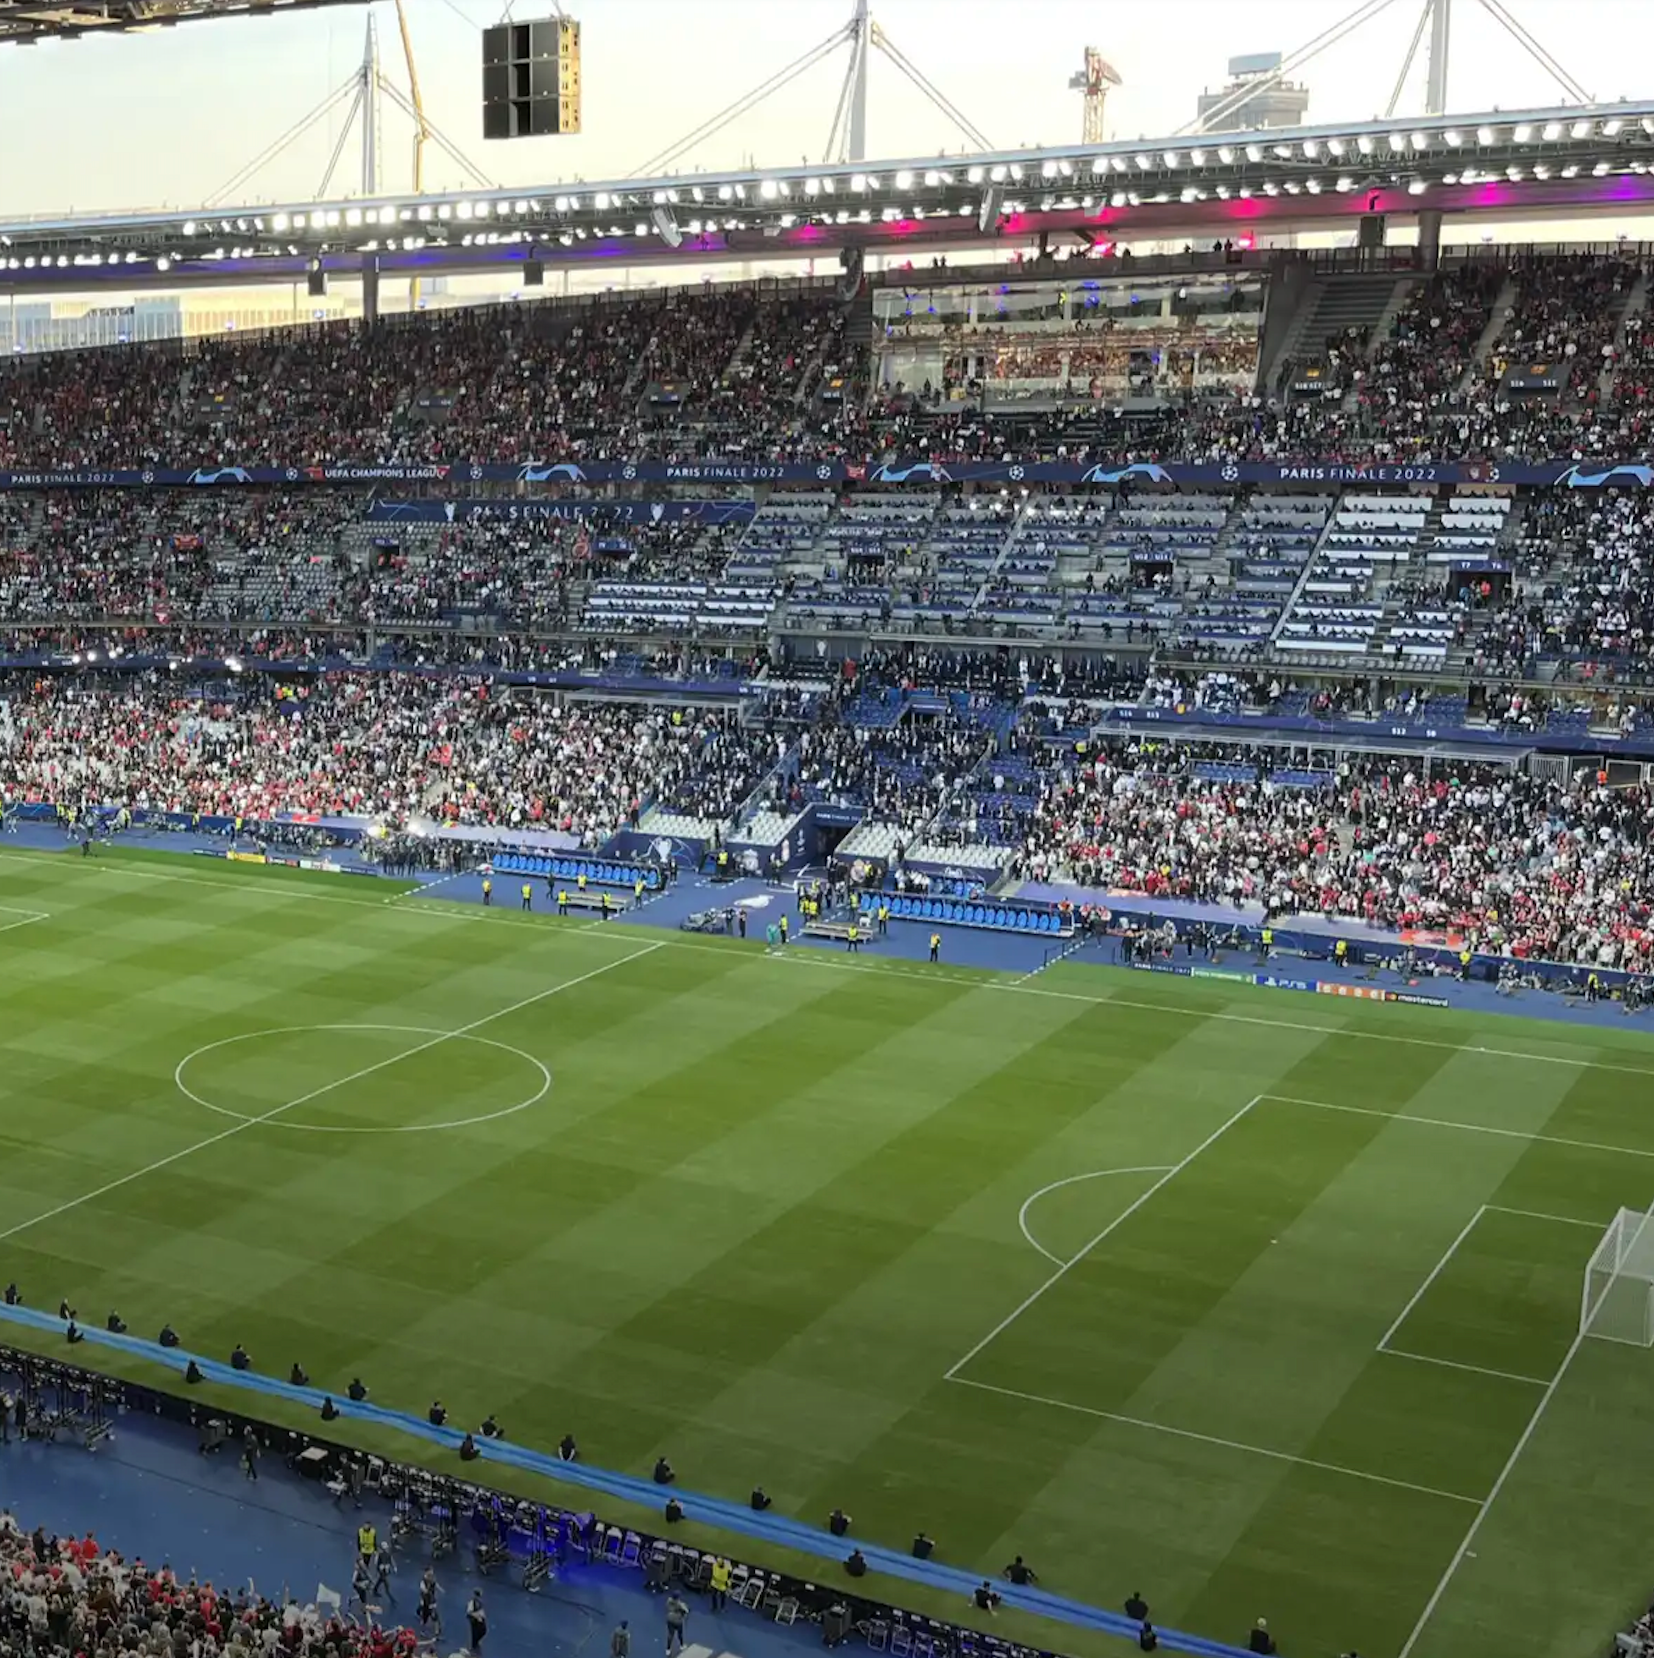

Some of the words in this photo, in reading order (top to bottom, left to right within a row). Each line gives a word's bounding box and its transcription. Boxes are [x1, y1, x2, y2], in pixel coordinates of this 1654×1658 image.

[324, 469, 348, 480] UEFA
[349, 468, 404, 479] CHAMPIONS
[666, 466, 701, 477] PARIS
[702, 467, 747, 477] FINALE
[752, 467, 785, 477] 2022
[1280, 467, 1325, 479] PARIS
[1329, 468, 1387, 480] FINALE
[1394, 468, 1437, 480] 2022
[11, 473, 41, 484] PARIS
[44, 473, 83, 484] FINALE
[87, 472, 116, 483] 2022
[1279, 978, 1307, 990] PS5
[1397, 994, 1449, 1007] mastercard
